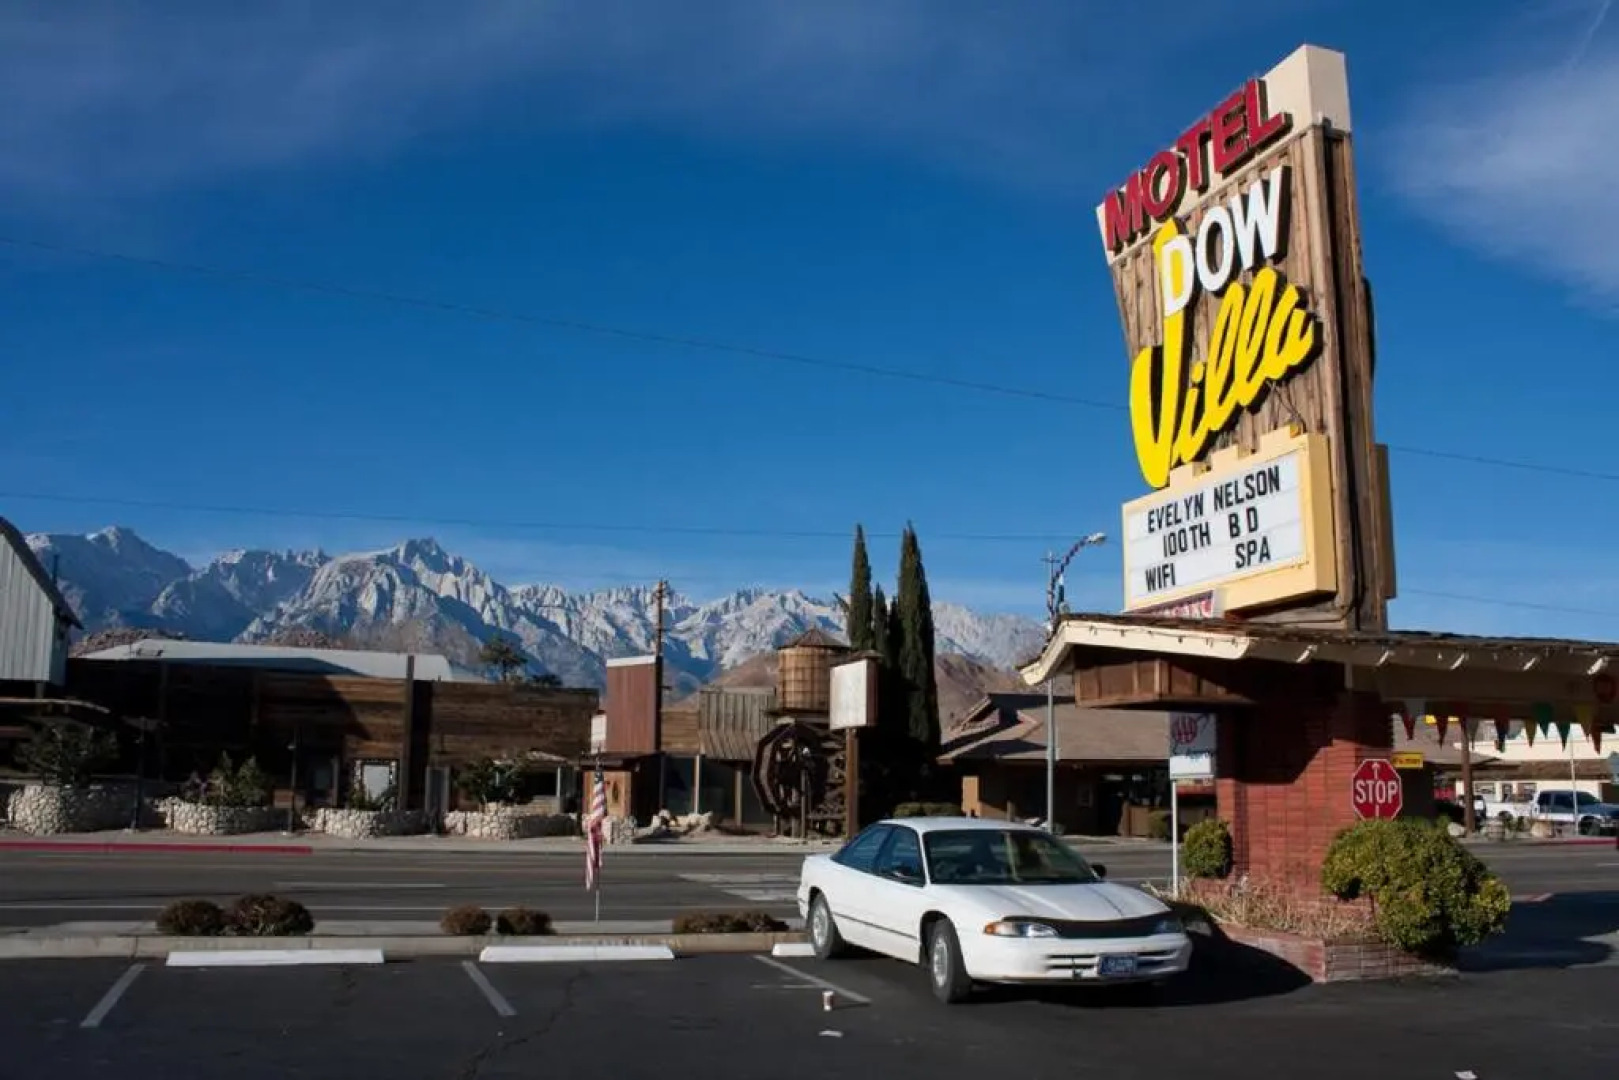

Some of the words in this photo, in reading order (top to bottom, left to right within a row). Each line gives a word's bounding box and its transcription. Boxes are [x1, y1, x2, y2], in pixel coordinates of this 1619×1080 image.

[1104, 78, 1288, 250] MOTEL
[1161, 166, 1286, 317] DOW
[1129, 217, 1316, 489] Villa
[1147, 491, 1204, 534] EVELYN
[1213, 466, 1281, 512] NELSON
[1162, 522, 1212, 557] 100TH
[1228, 512, 1240, 538] B
[1247, 506, 1258, 532] D
[1145, 562, 1176, 592] WIFI
[1234, 537, 1272, 569] SPA
[1354, 779, 1399, 804] STOP
